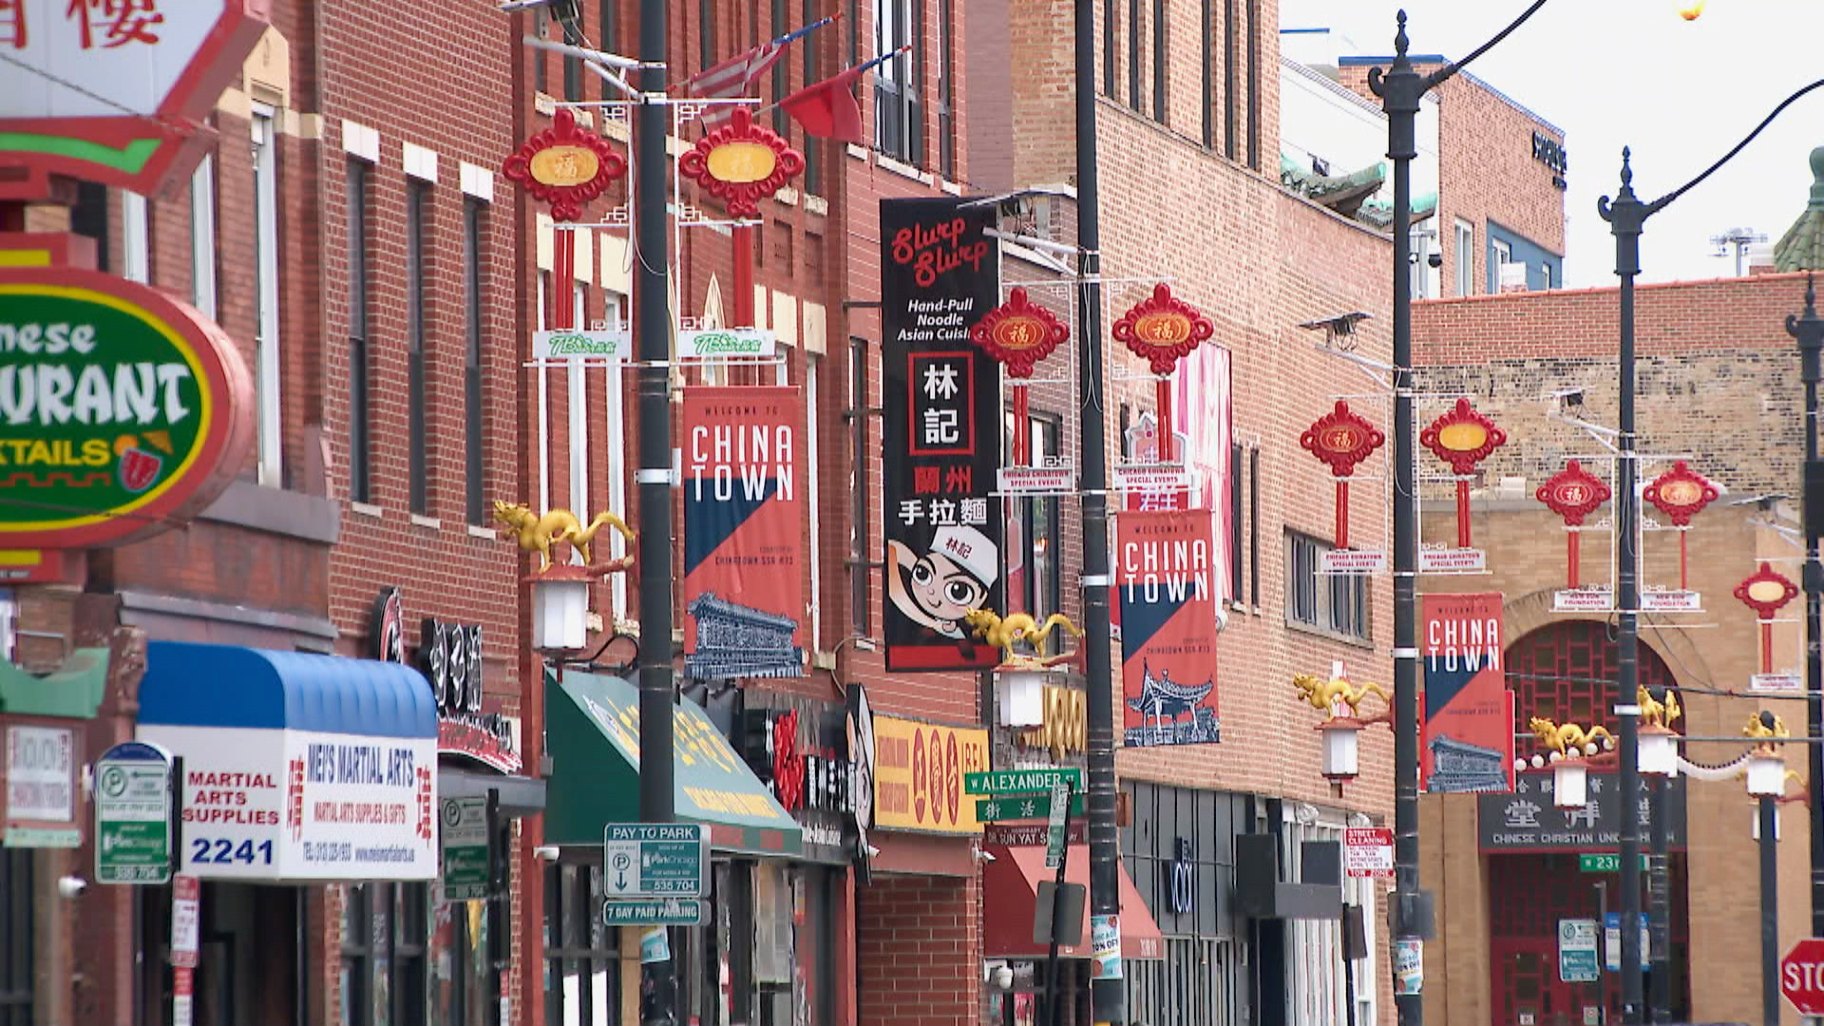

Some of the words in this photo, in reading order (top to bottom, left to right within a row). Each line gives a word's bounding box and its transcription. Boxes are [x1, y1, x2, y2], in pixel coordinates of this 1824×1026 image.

[892, 217, 966, 264] Slurp
[913, 241, 989, 288] Slurp
[908, 298, 973, 312] Hand-Pull
[917, 313, 963, 326] Noodle
[897, 327, 933, 341] Asian
[937, 326, 971, 341] Cuisi
[705, 406, 757, 416] WELCOME
[924, 364, 960, 444] 林記
[692, 425, 793, 463] CHINA
[691, 464, 793, 502] TOWN
[914, 466, 972, 494] 蘭州
[1126, 476, 1152, 484] SPECIAL
[898, 498, 988, 526] 手拉麵
[945, 536, 973, 561] 林記
[1125, 540, 1207, 572] CHINA
[1124, 571, 1208, 604] TOWN
[1429, 619, 1499, 646] CHINA
[1428, 646, 1500, 673] TOWN
[338, 745, 384, 784] MARTIAL
[387, 748, 414, 788] ARTS
[188, 771, 278, 789] MARTIAL
[971, 779, 979, 789] W
[982, 773, 1061, 791] ALEXANDER
[194, 790, 248, 807] ARTS
[182, 809, 280, 827] SUPPLIES
[314, 801, 338, 823] MARTIAL
[340, 802, 354, 823] ARTS
[355, 803, 383, 824] SUPPLIES
[389, 804, 406, 824] GIFTS
[613, 828, 636, 839] PAY
[640, 828, 656, 839] TO
[660, 827, 694, 838] PARK
[1000, 834, 1016, 845] SUN
[1018, 834, 1036, 844] YAT
[1348, 830, 1376, 838] STREET
[1348, 837, 1388, 845] CLEANING
[1493, 834, 1535, 844] CHINESE
[1541, 834, 1593, 844] CHRISTIAN
[191, 838, 274, 866] 2241
[677, 880, 695, 890] 704
[607, 908, 613, 918] 7
[616, 908, 633, 918] DAY
[635, 907, 656, 918] PAID
